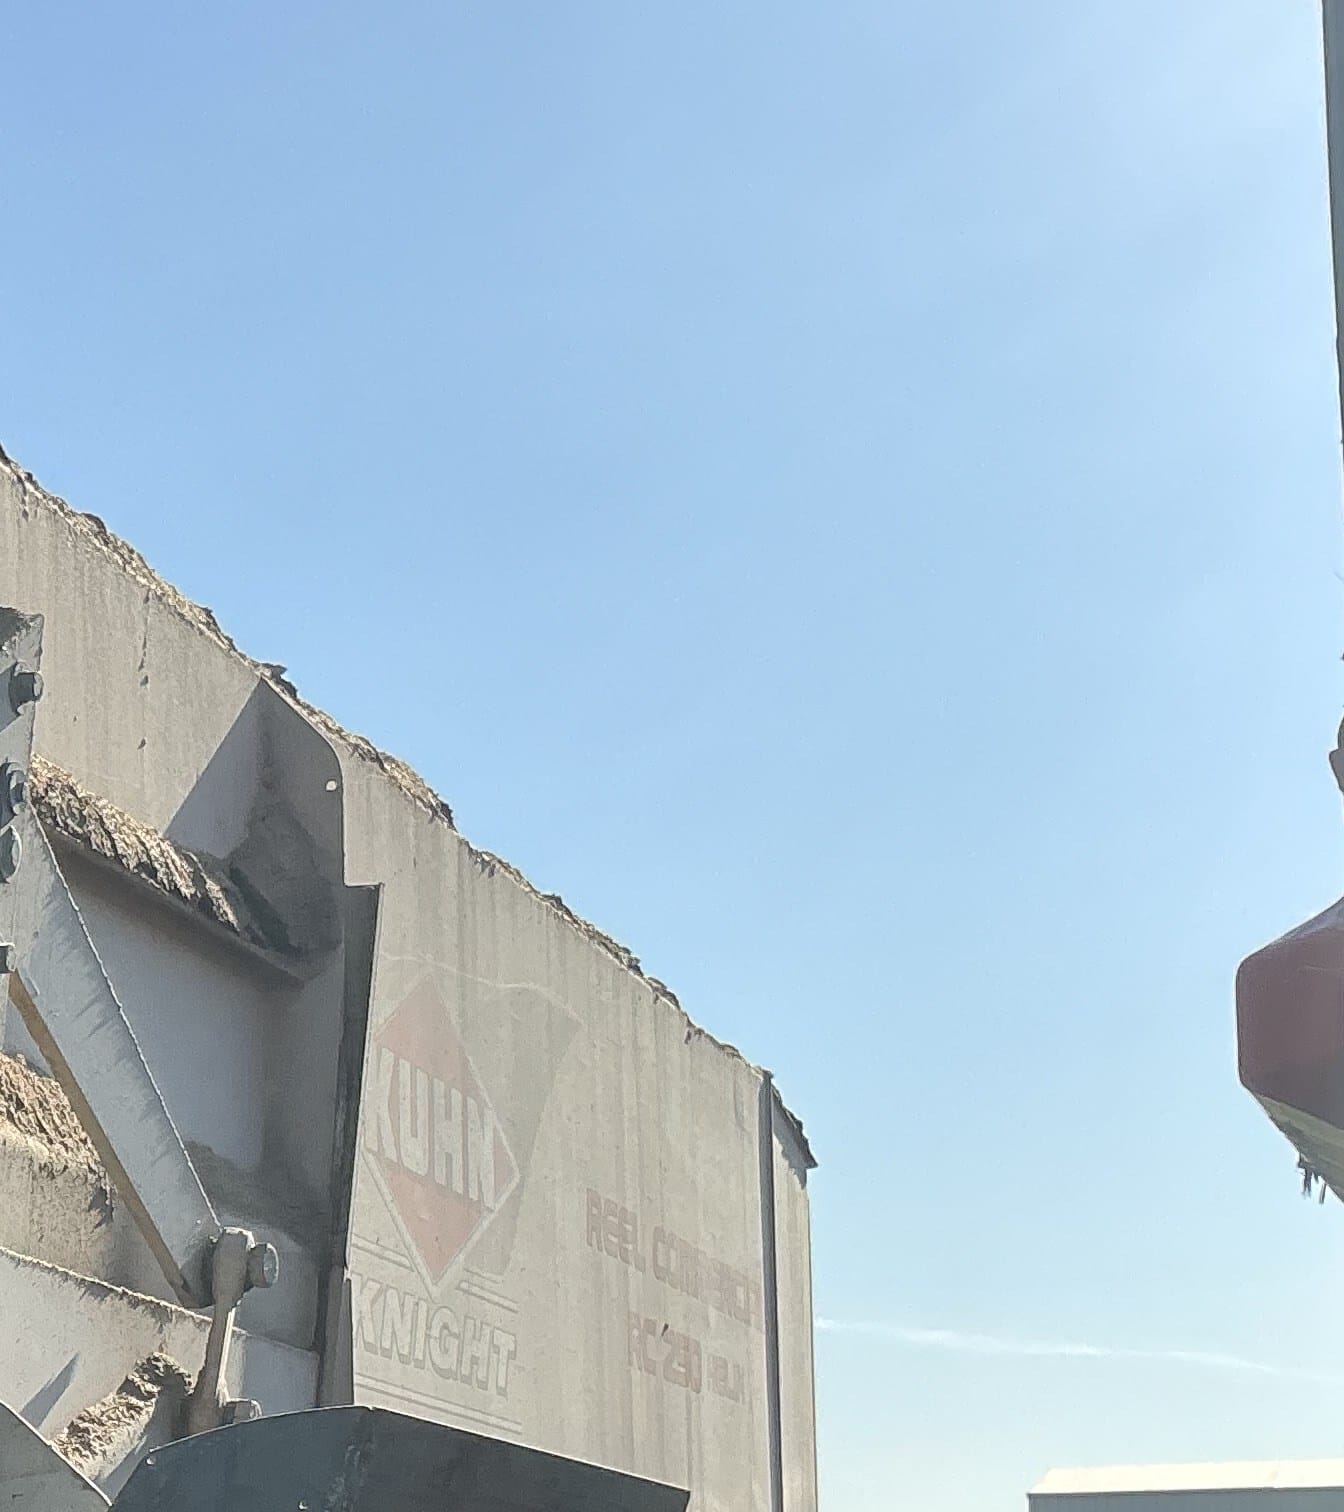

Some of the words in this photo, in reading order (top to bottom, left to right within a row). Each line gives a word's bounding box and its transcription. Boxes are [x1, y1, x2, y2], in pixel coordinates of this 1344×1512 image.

[363, 1047, 495, 1213] KUHN
[586, 1187, 646, 1273] REEL
[351, 1272, 517, 1401] KNIGHT
